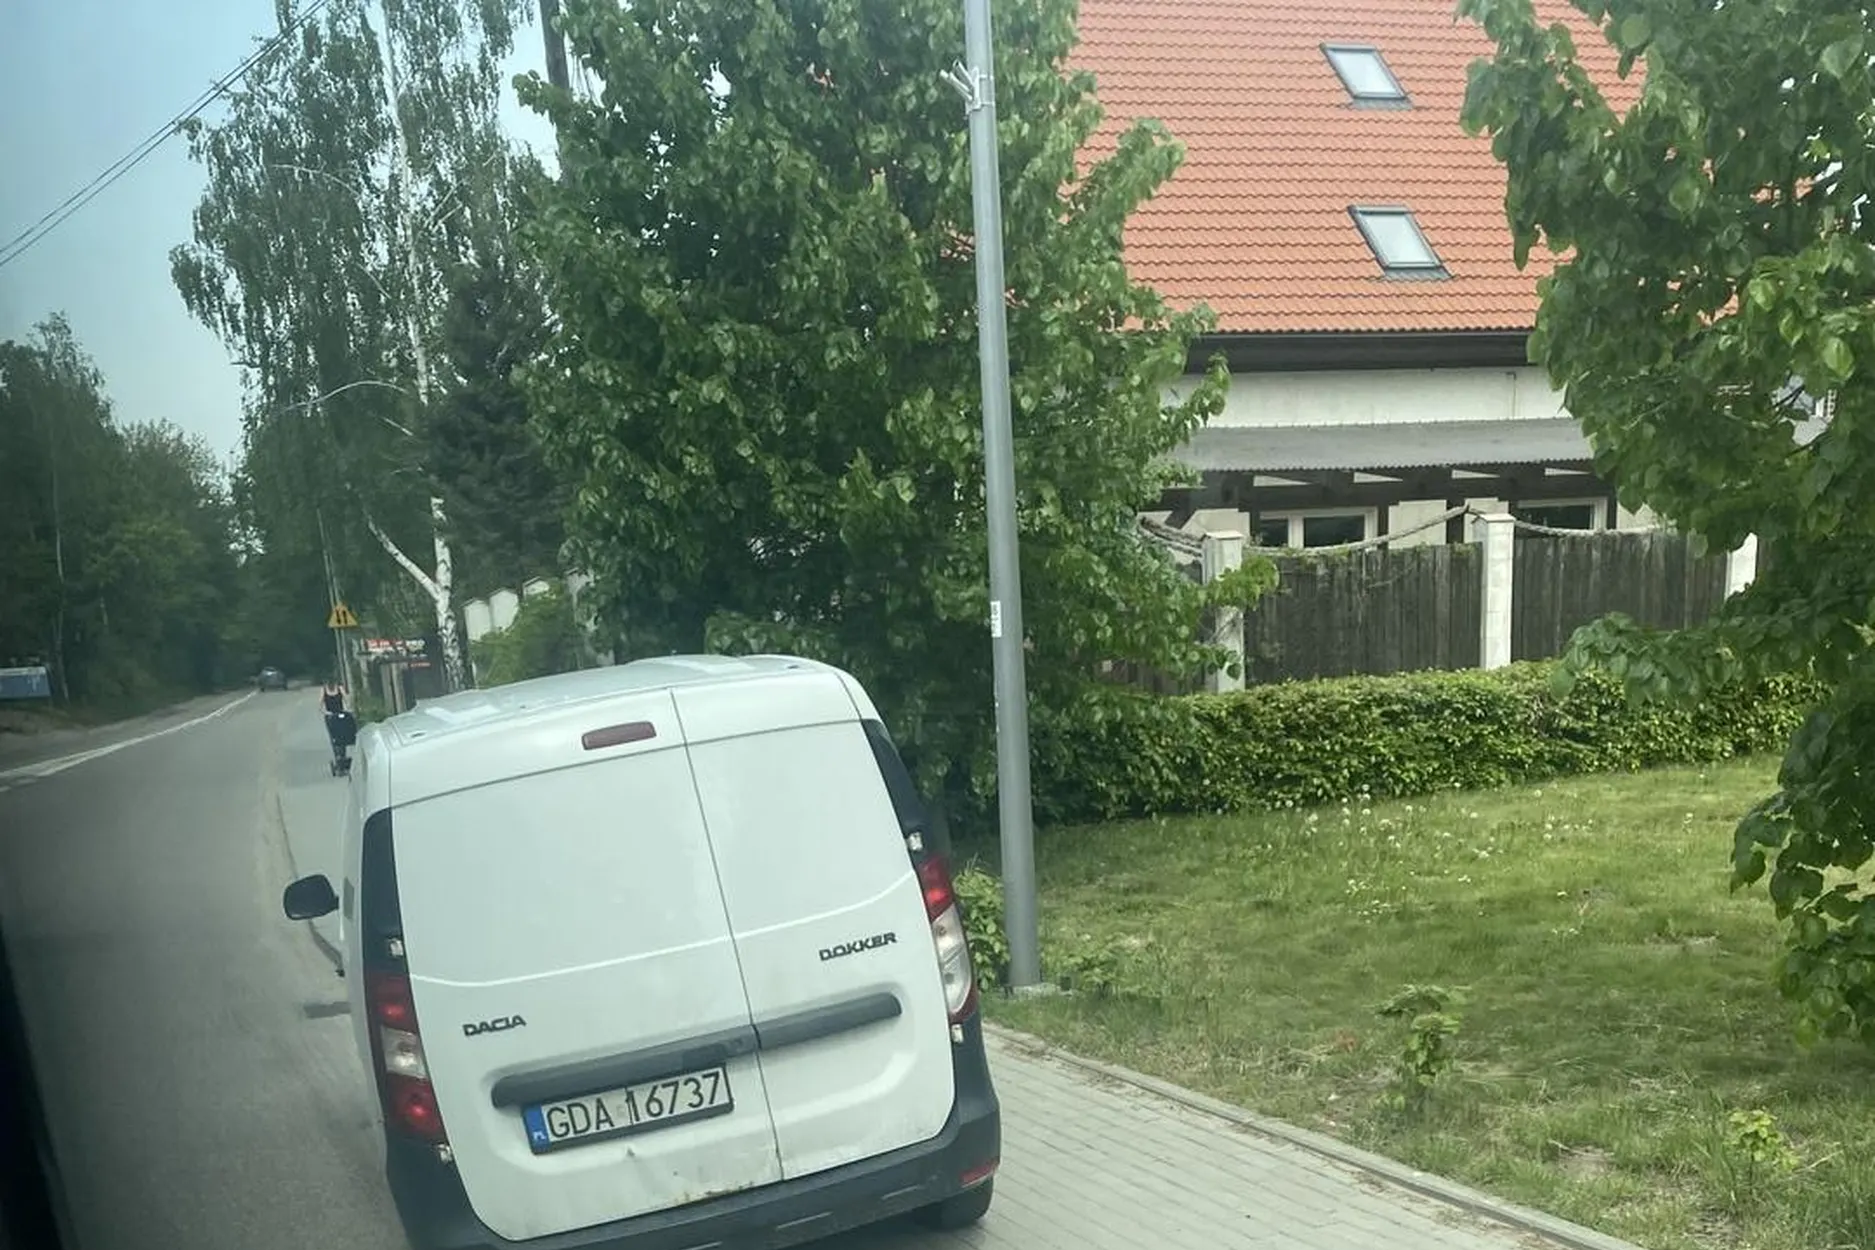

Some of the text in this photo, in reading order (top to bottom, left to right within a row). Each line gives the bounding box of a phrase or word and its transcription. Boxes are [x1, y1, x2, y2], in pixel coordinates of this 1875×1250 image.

[818, 931, 898, 961] DOKKER
[462, 1014, 527, 1037] DACIA
[546, 1070, 721, 1138] GDA 16737
